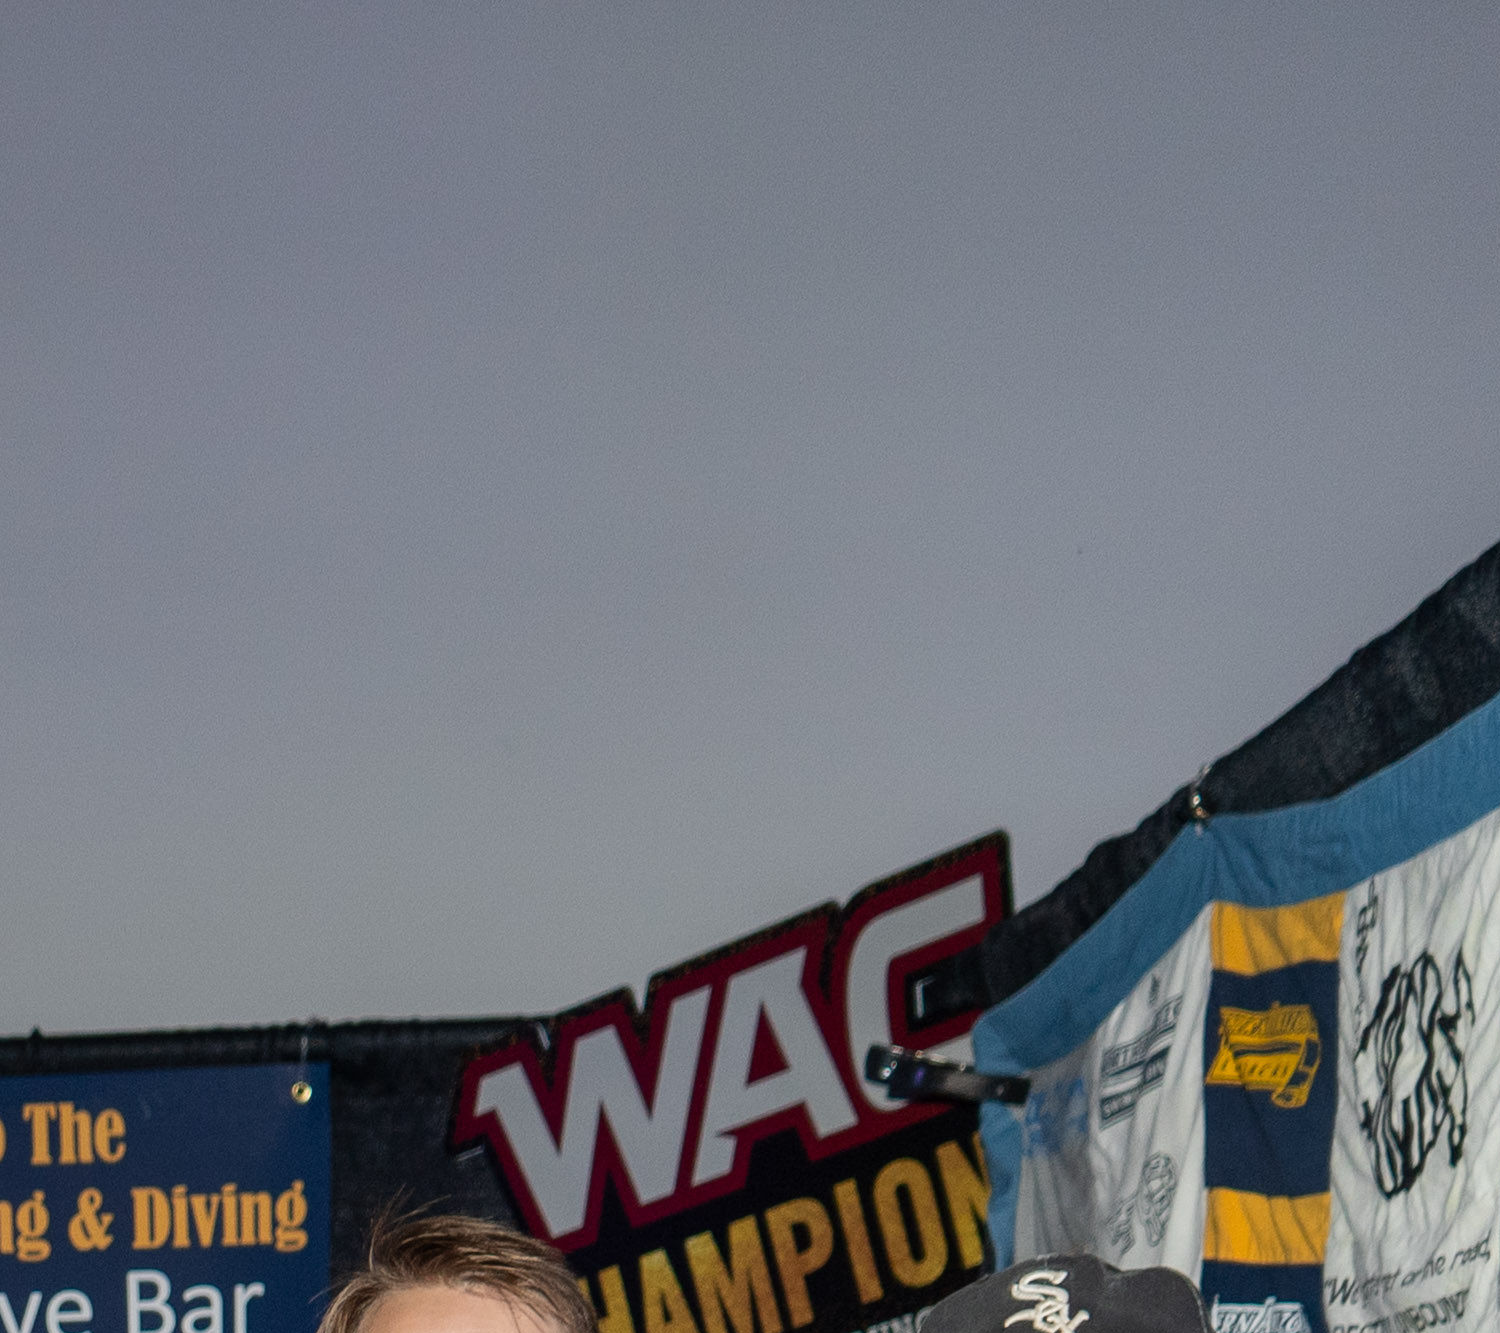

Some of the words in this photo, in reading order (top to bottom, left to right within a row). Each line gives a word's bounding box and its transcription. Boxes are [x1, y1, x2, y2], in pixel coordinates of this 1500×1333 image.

[474, 870, 986, 1240] WAC
[23, 1101, 127, 1166] The
[69, 1189, 113, 1252] &
[132, 1181, 308, 1253] Diving
